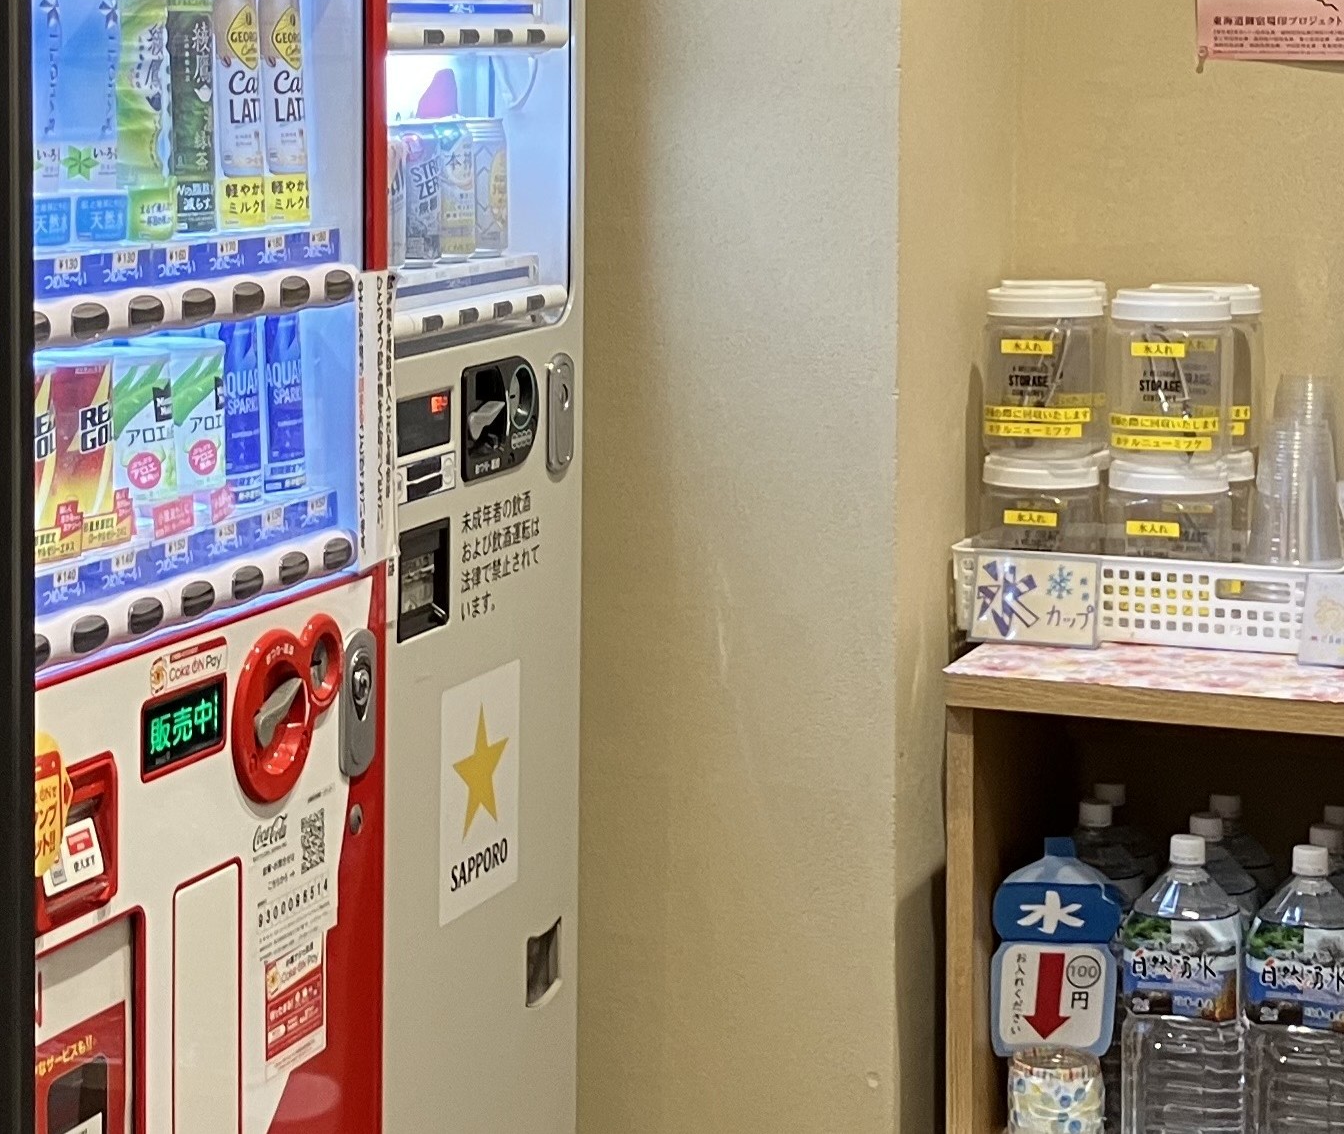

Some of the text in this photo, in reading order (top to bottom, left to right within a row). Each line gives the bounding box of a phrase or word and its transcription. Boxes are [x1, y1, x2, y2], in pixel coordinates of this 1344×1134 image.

[462, 490, 531, 534] 未成年者の飲酒
[462, 516, 540, 564] および飲酒運転は
[461, 544, 540, 594] 法律で禁止されて
[461, 591, 496, 622] います。
[976, 560, 1094, 638] 氷 カップ
[450, 837, 508, 893] SAPPORO
[1017, 890, 1085, 934] 水
[1011, 953, 1027, 1035] お入れください
[1070, 965, 1098, 978] 100
[1071, 991, 1089, 1010] 円
